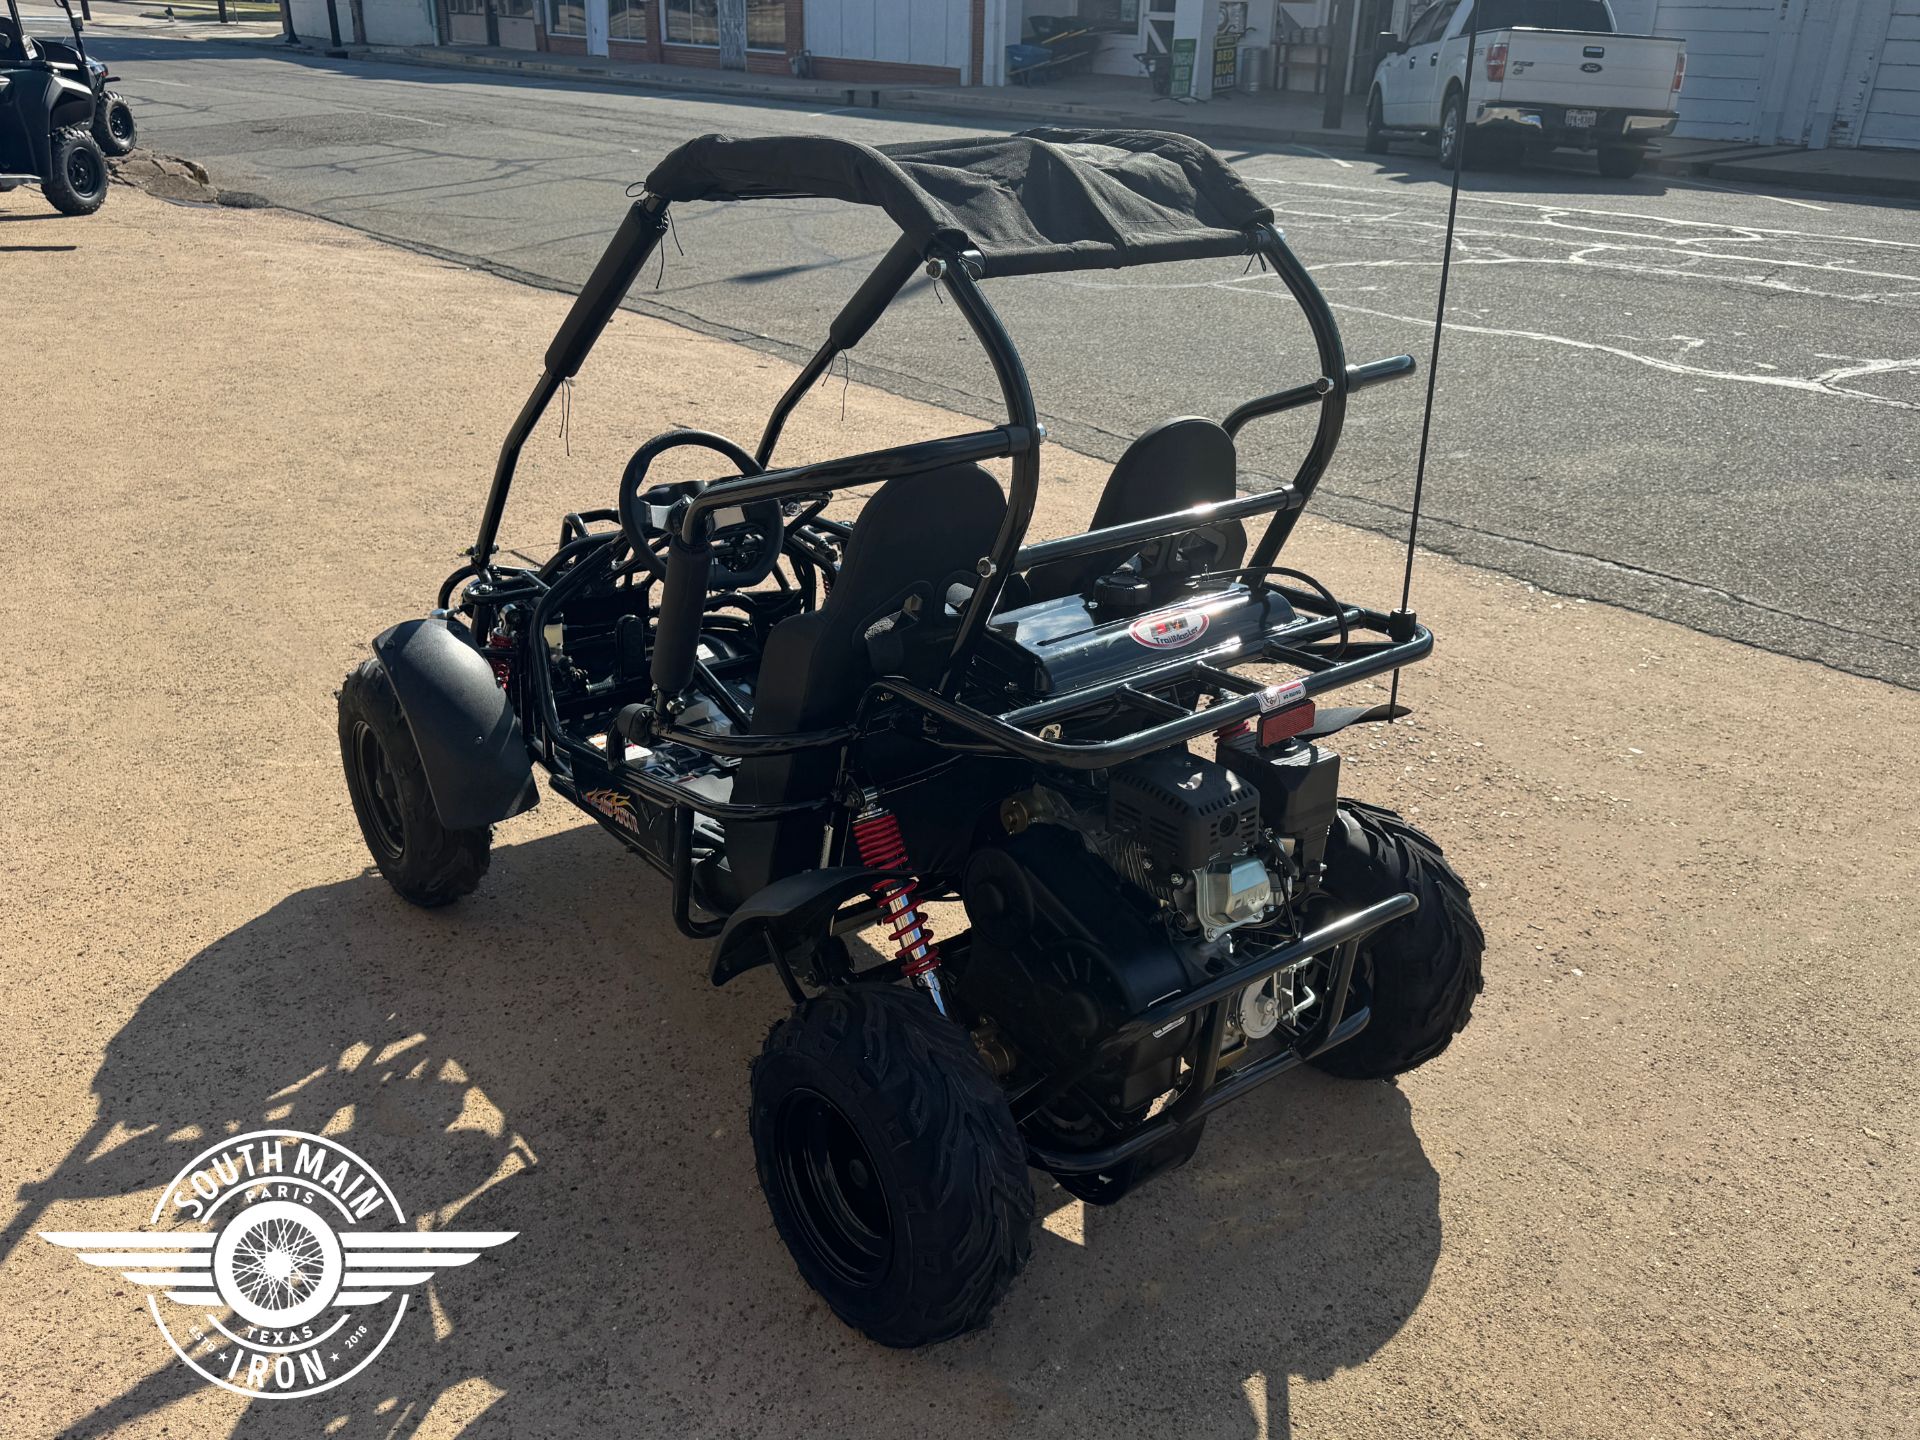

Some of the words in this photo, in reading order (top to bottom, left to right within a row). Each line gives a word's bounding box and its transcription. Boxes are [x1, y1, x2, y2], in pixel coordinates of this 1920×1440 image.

[1216, 49, 1234, 61] BED
[1215, 63, 1234, 75] BUG
[1214, 74, 1234, 88] KILLER
[1153, 625, 1199, 645] TrailMaster
